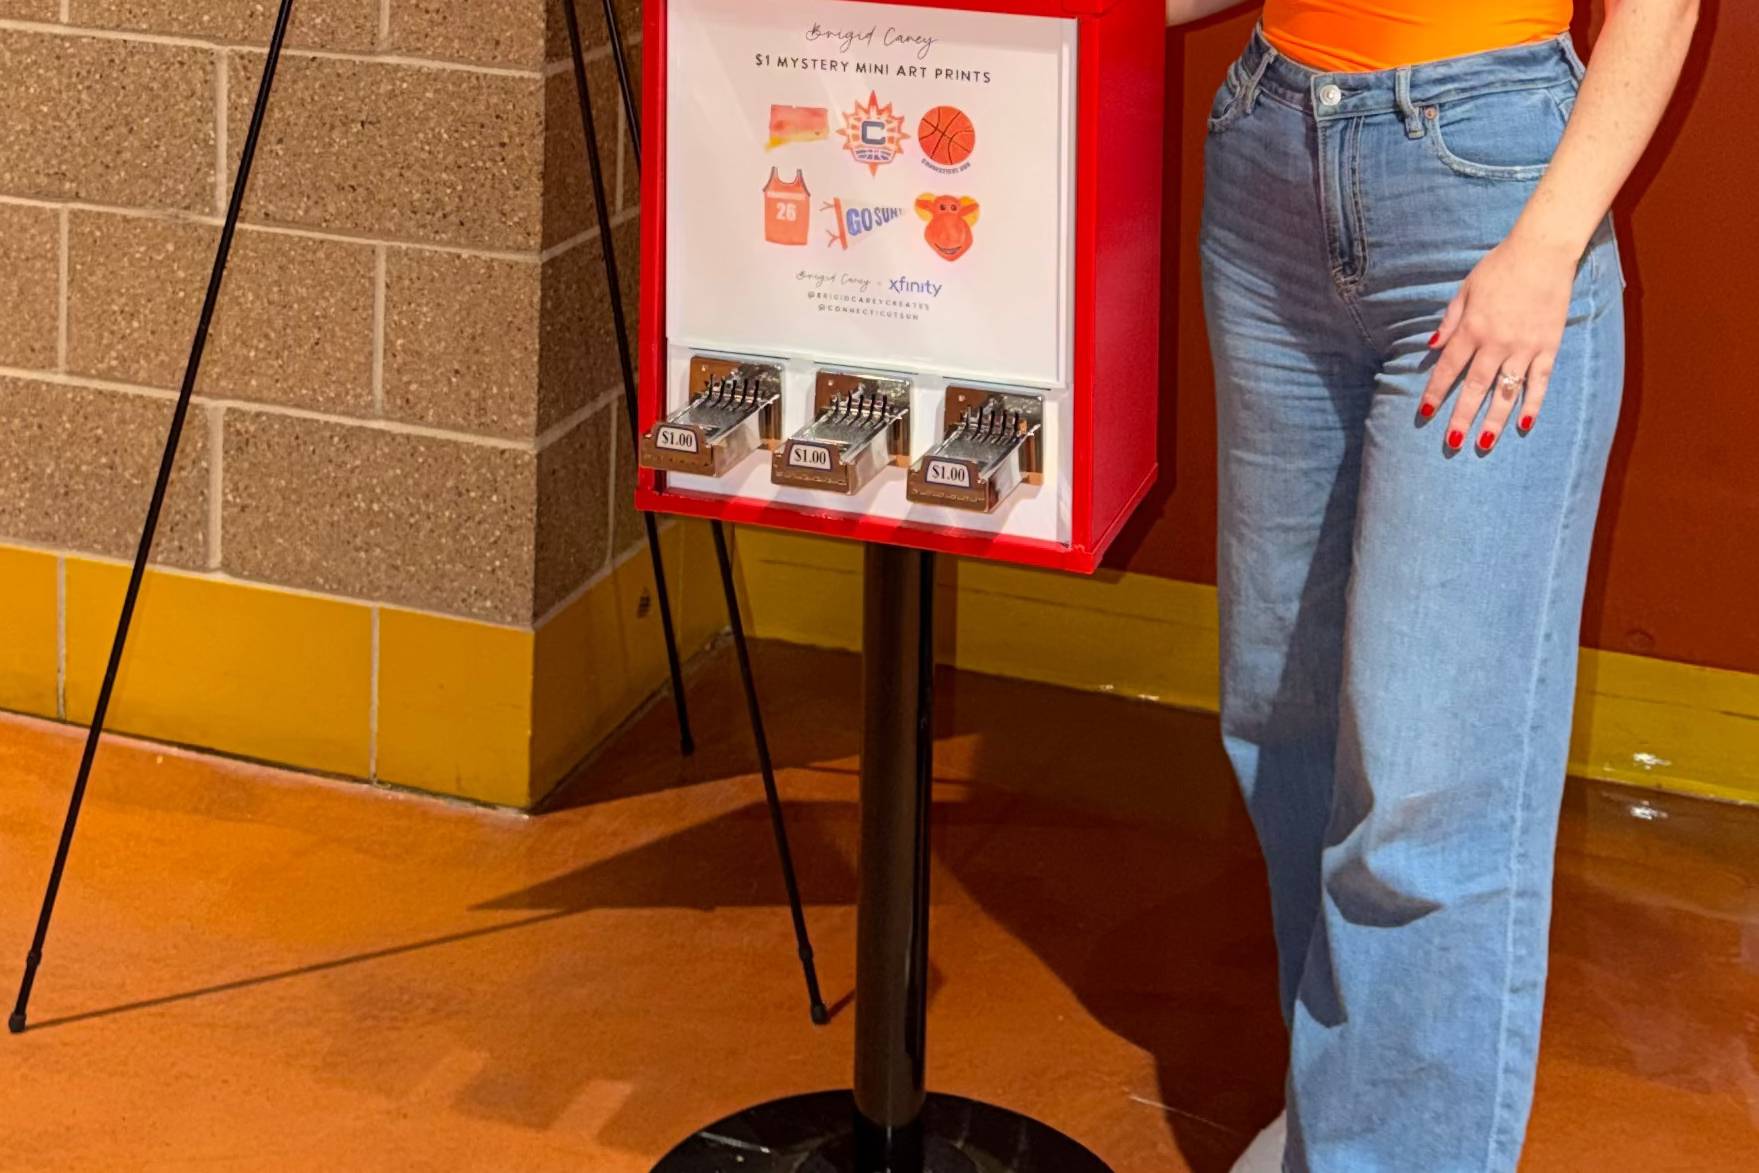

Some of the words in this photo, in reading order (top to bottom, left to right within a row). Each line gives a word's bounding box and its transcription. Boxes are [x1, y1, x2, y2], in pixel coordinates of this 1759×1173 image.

[805, 23, 876, 54] Brigid
[883, 27, 940, 60] Carey
[755, 53, 771, 66] $1
[776, 56, 849, 73] MYSTERY
[855, 62, 890, 75] MINI
[896, 65, 928, 78] ART
[934, 68, 992, 84] PRINTS
[861, 120, 886, 145] C
[776, 202, 797, 222] 26
[846, 208, 873, 236] GO
[888, 276, 943, 297] xfinity
[662, 431, 693, 447] $1.00
[794, 449, 827, 465] $1.00
[932, 465, 965, 482] $1.00
